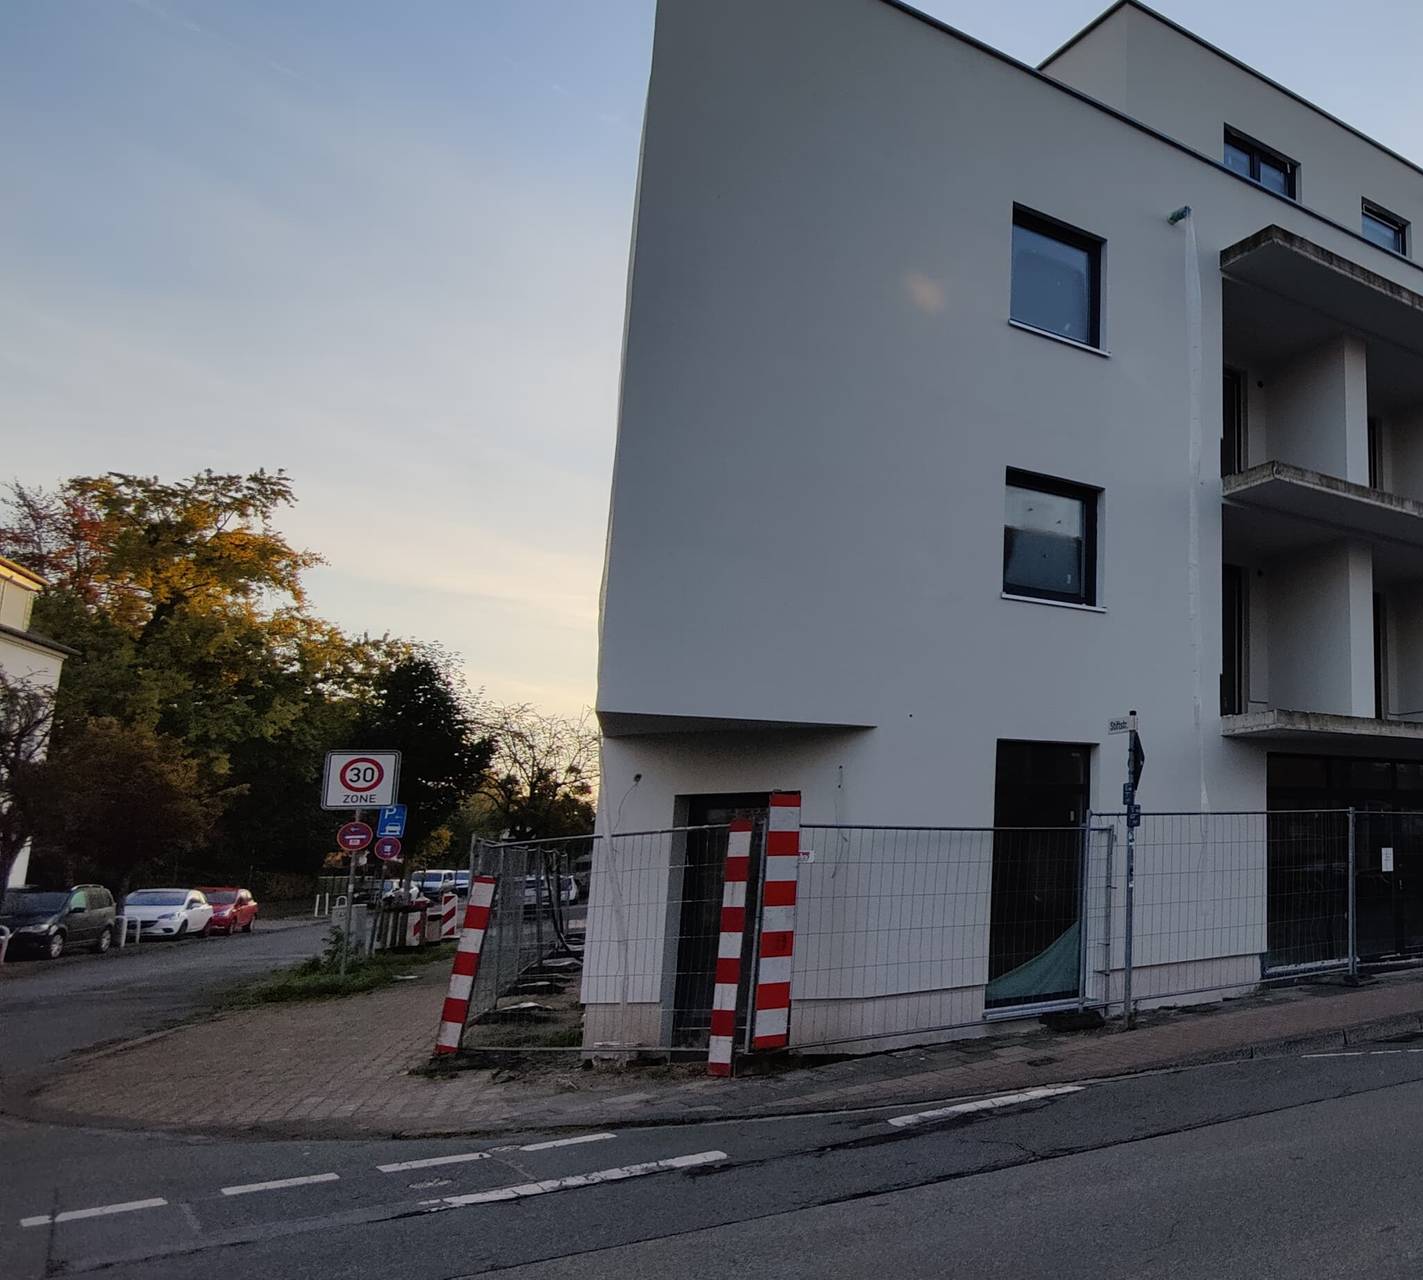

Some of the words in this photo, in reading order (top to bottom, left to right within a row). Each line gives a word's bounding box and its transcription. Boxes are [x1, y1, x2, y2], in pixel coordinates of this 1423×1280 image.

[348, 767, 375, 783] 30
[342, 794, 377, 803] ZONE
[384, 807, 396, 819] P
